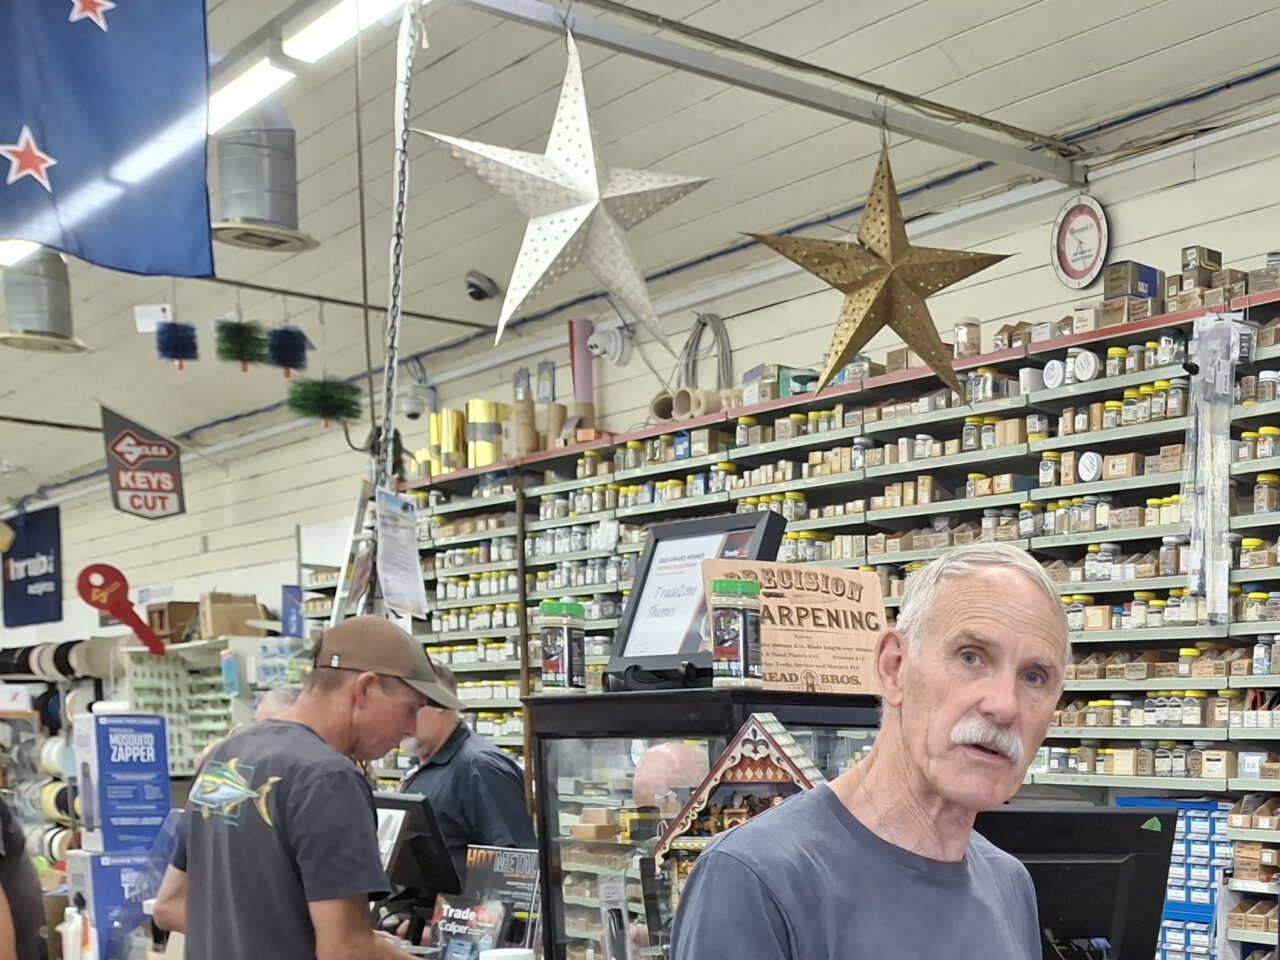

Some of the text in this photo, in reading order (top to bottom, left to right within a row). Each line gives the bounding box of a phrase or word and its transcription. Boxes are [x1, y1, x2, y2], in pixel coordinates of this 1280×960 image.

[118, 470, 175, 491] KEYS
[130, 494, 170, 512] CUT
[761, 604, 881, 632] ARPENING
[820, 673, 862, 685] BROS.
[108, 732, 155, 748] MOSQUITO
[110, 746, 156, 763] ZAPPER
